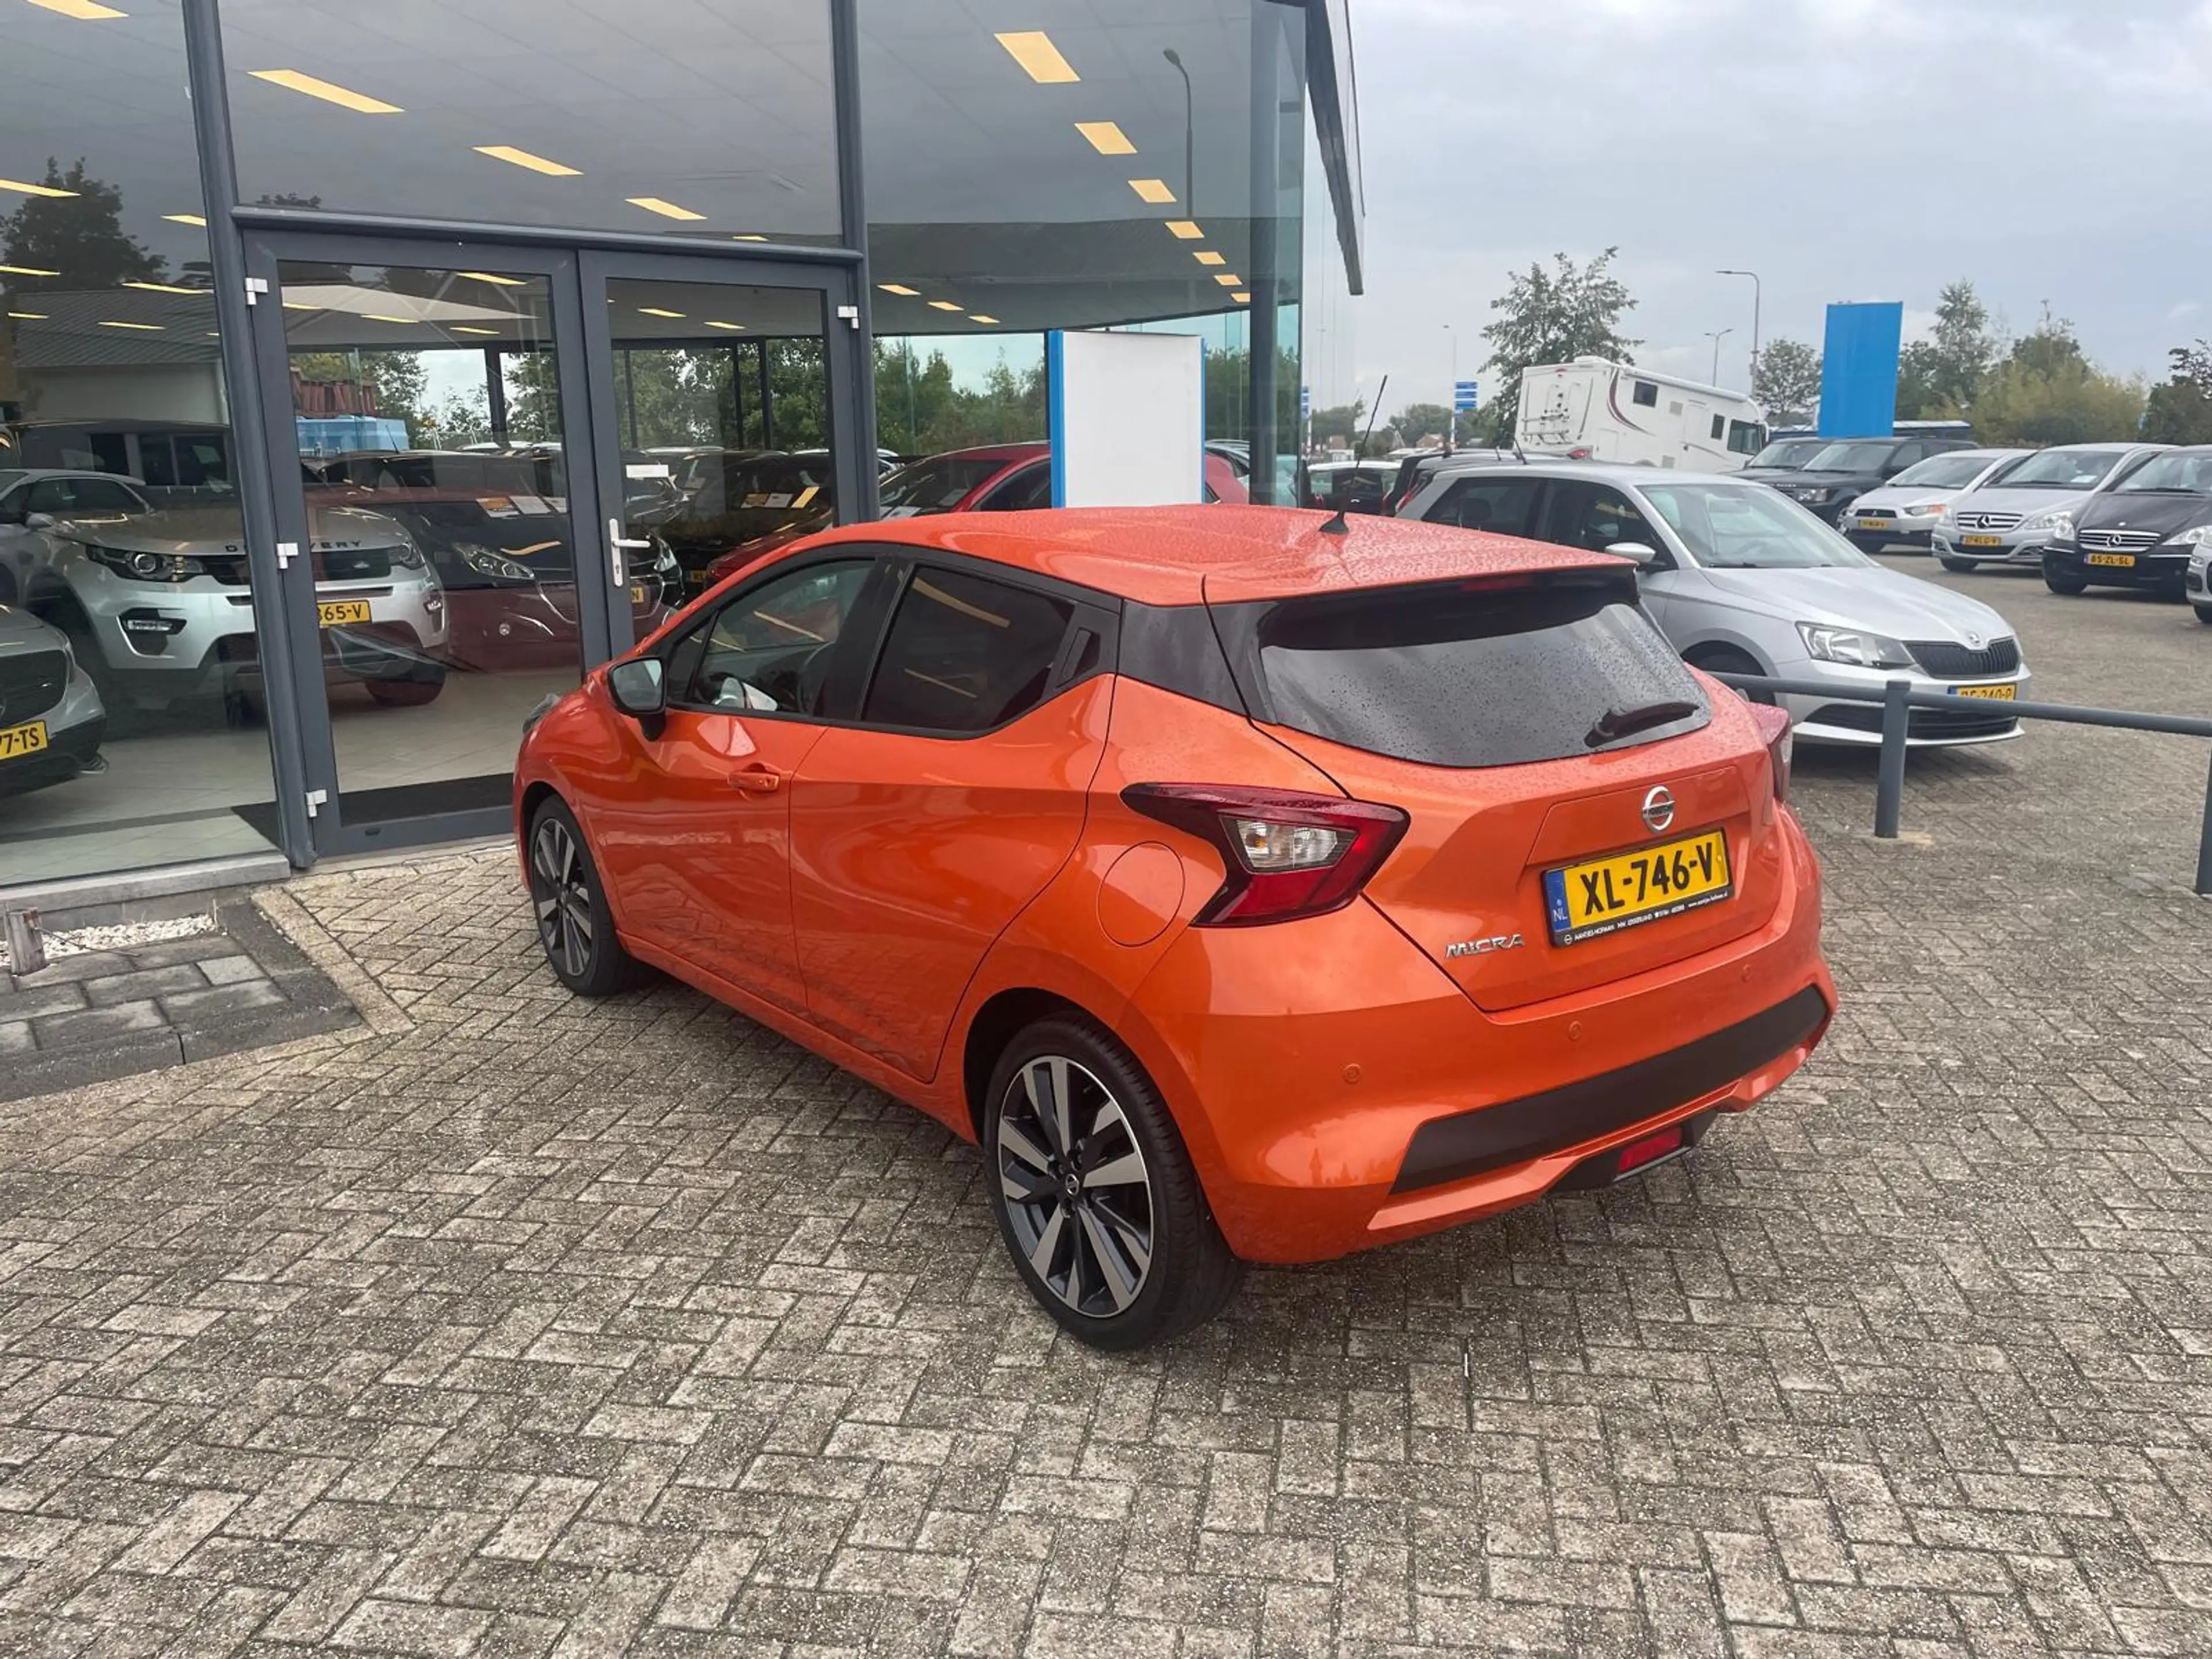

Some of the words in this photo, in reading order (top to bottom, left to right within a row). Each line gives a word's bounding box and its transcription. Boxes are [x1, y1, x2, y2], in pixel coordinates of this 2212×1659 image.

[0, 728, 40, 754] 7-TS
[1580, 842, 1713, 916] XL-746-V
[1553, 908, 1568, 922] NL
[1445, 933, 1525, 959] MICRA
